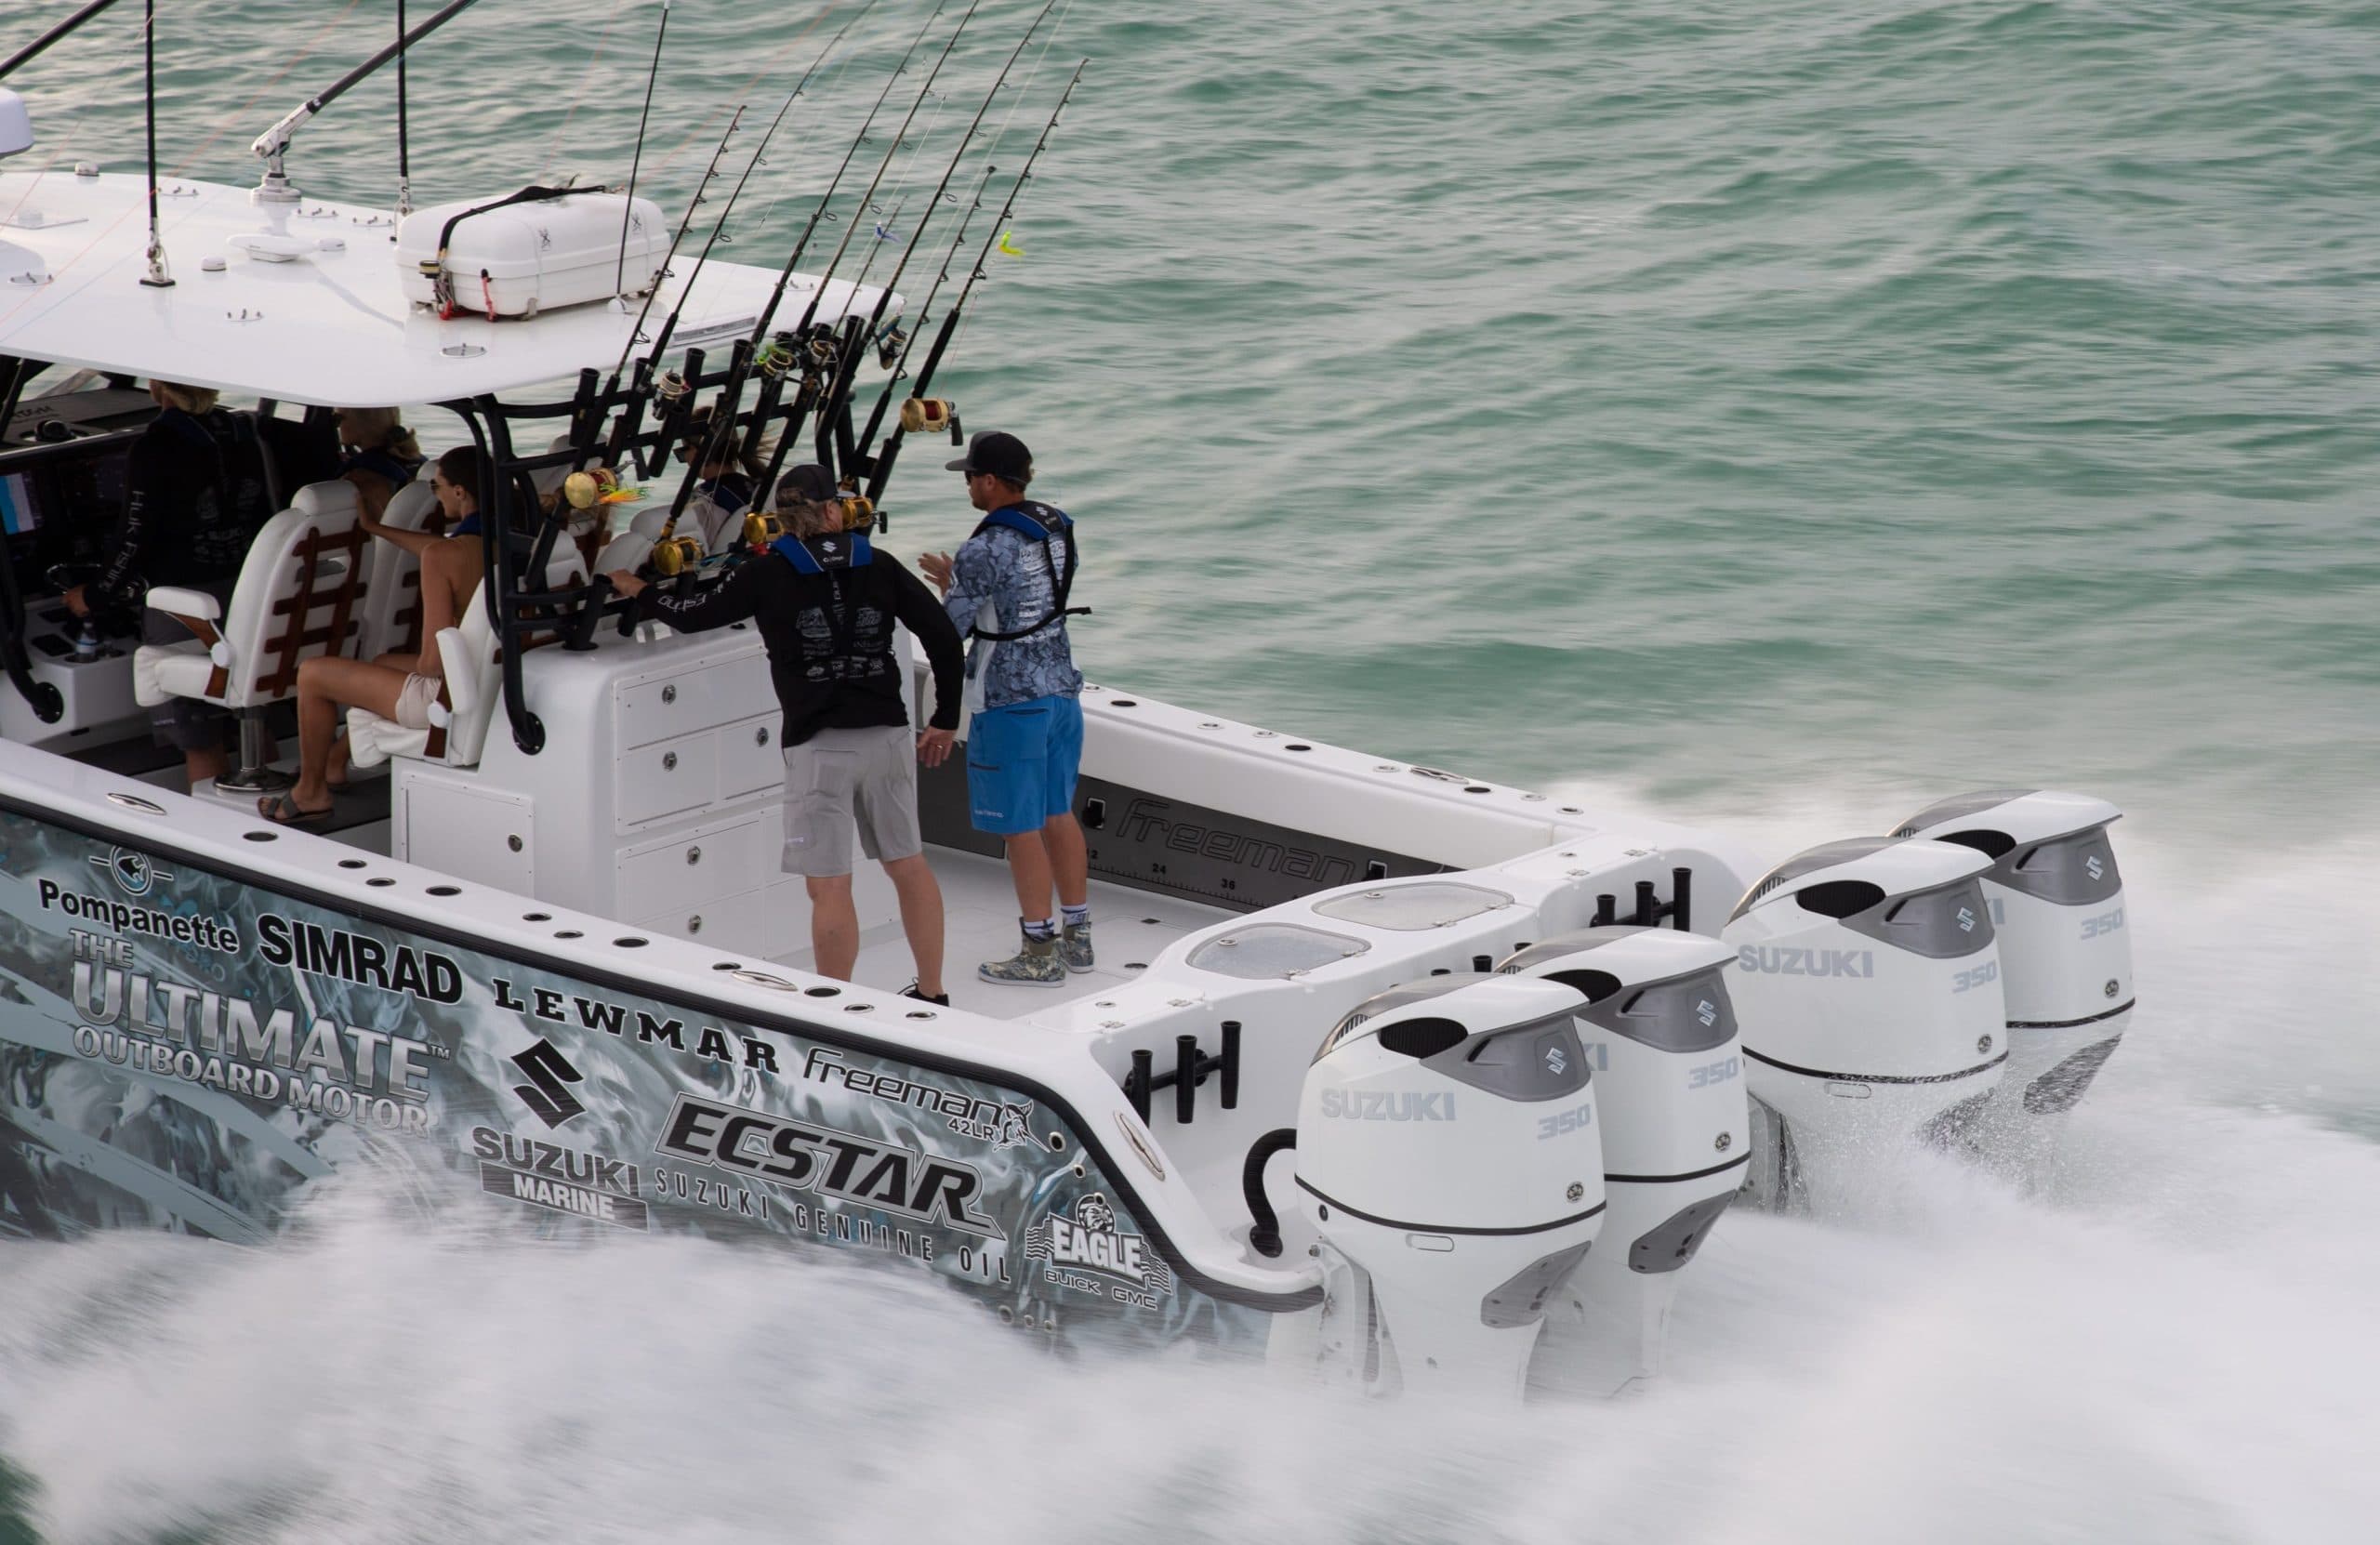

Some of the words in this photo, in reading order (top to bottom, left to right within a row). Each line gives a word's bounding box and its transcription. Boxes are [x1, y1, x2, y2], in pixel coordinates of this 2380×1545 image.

[1152, 863, 1167, 875] 24
[1220, 878, 1236, 890] 36
[38, 878, 240, 955] Pompanette
[2080, 906, 2123, 940] 350
[70, 929, 134, 969] THE
[257, 914, 463, 1005] SIMRAD
[1739, 944, 1873, 978] SUZUKI
[1952, 959, 1997, 994] 350
[71, 960, 432, 1103] ULTIMATE
[491, 978, 779, 1075] LEWMAR
[73, 1025, 280, 1102] OUTBOARD
[288, 1076, 435, 1139] MOTOR
[1688, 1055, 1739, 1089] 350
[1320, 1087, 1457, 1122] SUZUKI
[1537, 1104, 1591, 1141] 350
[947, 1119, 996, 1142] 42LR
[472, 1127, 641, 1197] SUZUKI
[661, 1098, 1004, 1235] ECSTAR
[513, 1172, 615, 1221] MARINE
[654, 1169, 769, 1221] SUZUKI
[794, 1204, 934, 1263] GENUINE
[959, 1245, 1012, 1284] OIL
[1051, 1220, 1144, 1280] EAGLE
[1044, 1269, 1101, 1295] BUICK
[1112, 1286, 1158, 1310] GMC
